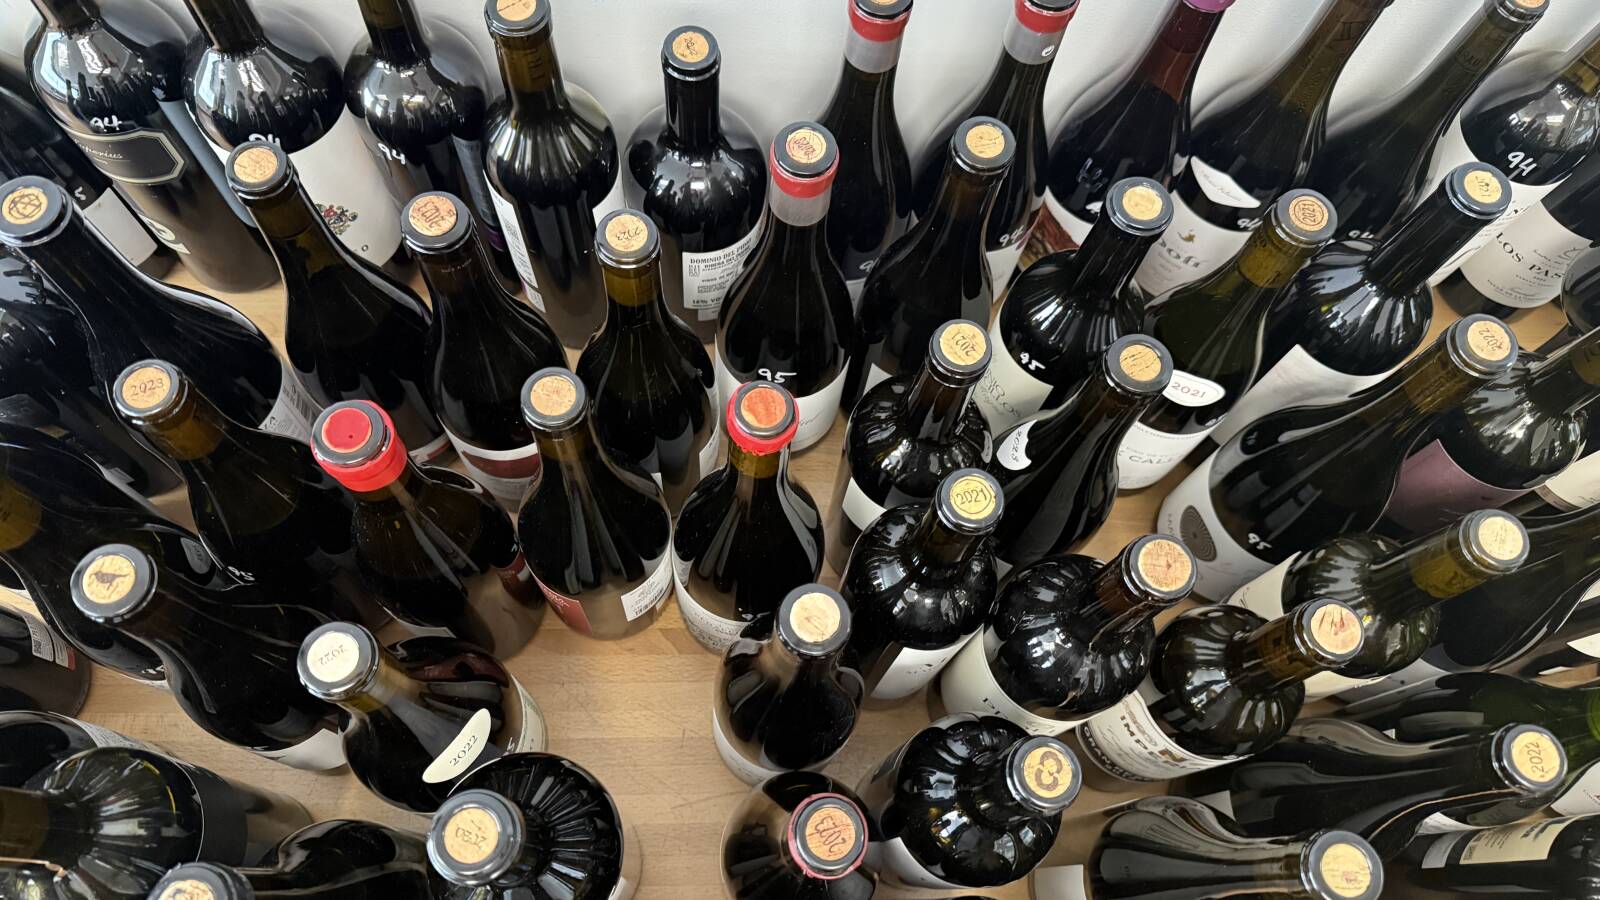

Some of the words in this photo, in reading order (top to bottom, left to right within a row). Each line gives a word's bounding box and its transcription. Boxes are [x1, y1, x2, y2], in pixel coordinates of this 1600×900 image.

[89, 115, 122, 132] 94
[377, 143, 406, 165] 94
[1507, 151, 1538, 177] 94
[1301, 202, 1317, 224] 2021
[999, 224, 1026, 248] 94
[1495, 231, 1525, 264] LOS
[690, 255, 722, 265] DOMINIO
[951, 331, 976, 357] 2021
[1478, 327, 1504, 352] 2022
[1019, 351, 1046, 371] 95
[130, 377, 164, 397] 2023
[758, 368, 797, 384] 95
[1171, 381, 1207, 399] 2021
[955, 487, 987, 506] 2021
[317, 643, 345, 666] 2022
[449, 734, 479, 767] 2022
[1524, 741, 1545, 773] 2022
[814, 815, 847, 854] 2023
